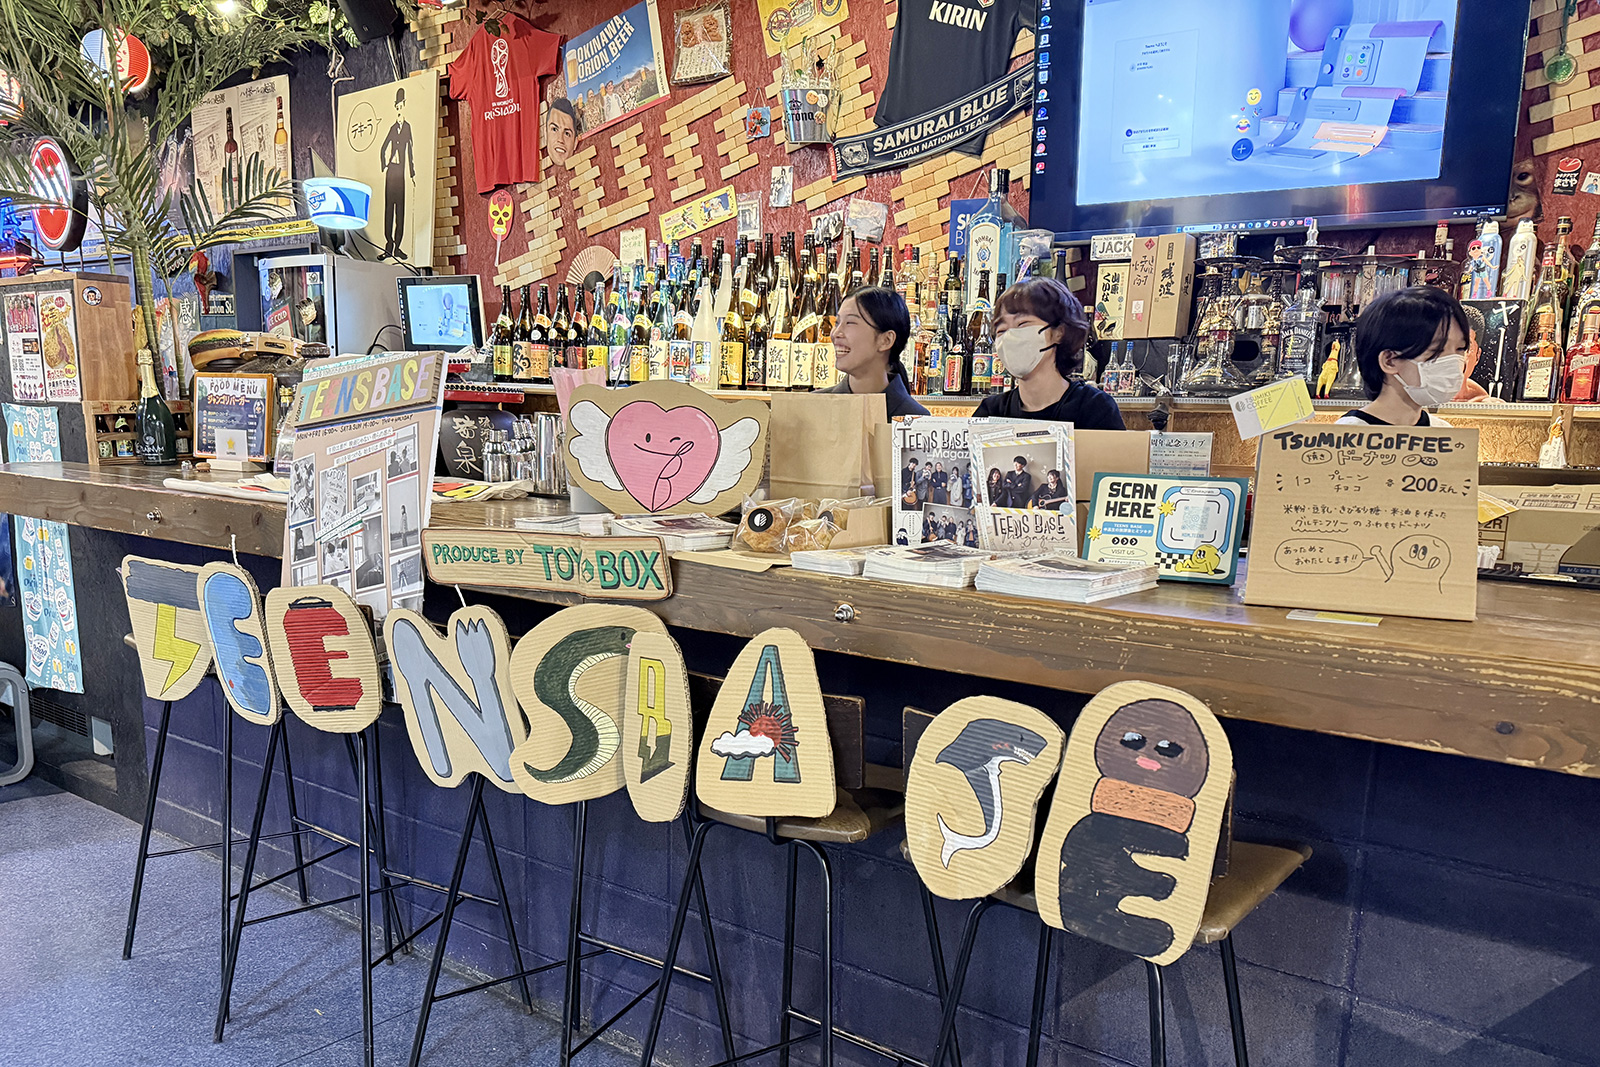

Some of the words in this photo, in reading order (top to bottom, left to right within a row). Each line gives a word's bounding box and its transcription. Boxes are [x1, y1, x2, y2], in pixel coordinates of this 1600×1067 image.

[929, 0, 988, 31] KIRIN
[577, 14, 628, 62] OKINAWA,
[578, 51, 609, 79] ORION
[608, 21, 635, 57] BEER
[352, 118, 374, 139] テキーラ
[873, 110, 955, 152] SAMURAI
[960, 83, 1009, 119] BLUE
[893, 148, 919, 161] JAPAN
[921, 129, 965, 151] NATIONAL
[964, 115, 990, 133] TEAM
[834, 147, 842, 171] KIRIN
[1098, 240, 1132, 254] JACK
[1102, 273, 1111, 302] くいな
[1110, 272, 1121, 295] 山原
[1159, 262, 1176, 297] 残波
[673, 346, 688, 376] 朝日
[210, 380, 231, 393] FOOD
[233, 380, 258, 395] MENU
[1245, 389, 1272, 403] TSUMIKI
[1246, 397, 1273, 412] COFFEE
[897, 427, 938, 453] TEENS
[942, 428, 969, 451] BASE
[1454, 441, 1465, 450] の
[1306, 452, 1326, 461] 焼き
[1337, 449, 1397, 466] ドーナツ
[1328, 469, 1370, 482] プレーン
[1108, 481, 1158, 500] SCAN
[1334, 484, 1361, 493] チョコ
[1104, 500, 1157, 519] HERE
[990, 512, 1030, 537] TEENS
[1034, 513, 1065, 536] BASE
[1283, 545, 1325, 555] あっためて
[432, 543, 501, 566] PRODUCE
[506, 548, 525, 565] BY
[533, 543, 583, 582] TOY
[595, 549, 665, 591] BOX
